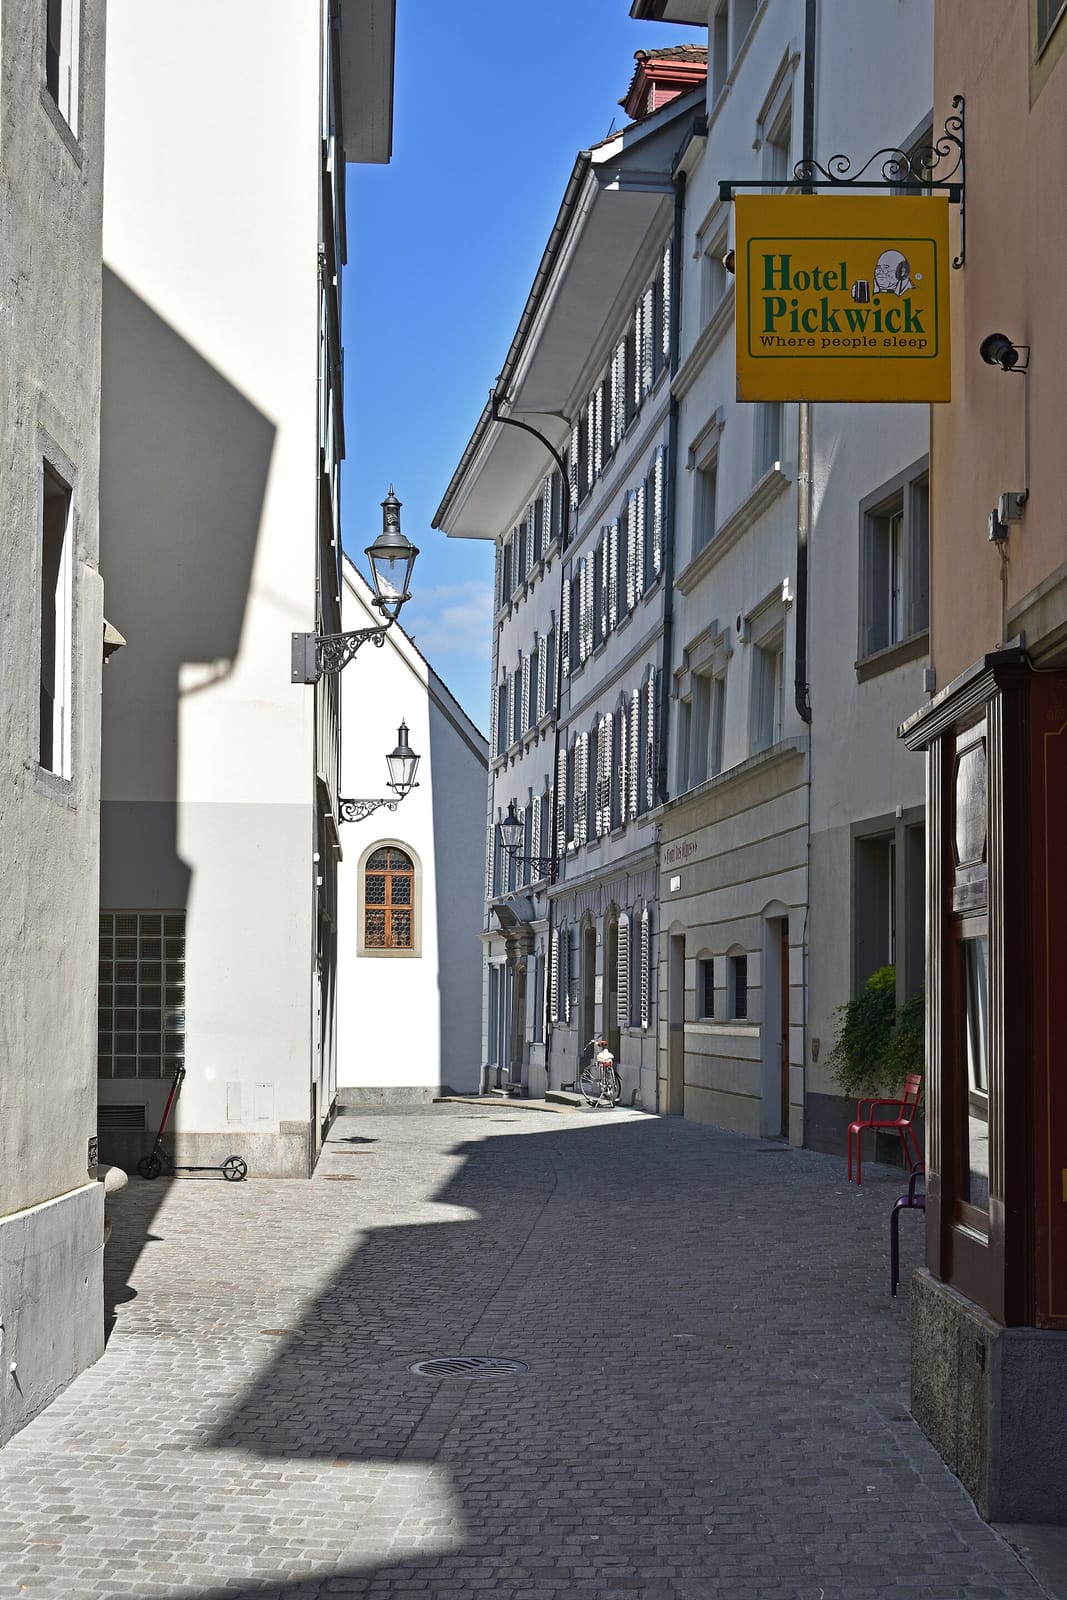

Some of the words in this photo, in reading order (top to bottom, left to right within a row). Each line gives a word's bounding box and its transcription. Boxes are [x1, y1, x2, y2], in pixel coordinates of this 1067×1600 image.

[761, 254, 848, 291] Hotel
[762, 296, 925, 333] Pickwick
[760, 335, 816, 347] Where
[821, 335, 877, 349] people
[883, 336, 928, 349] sleep
